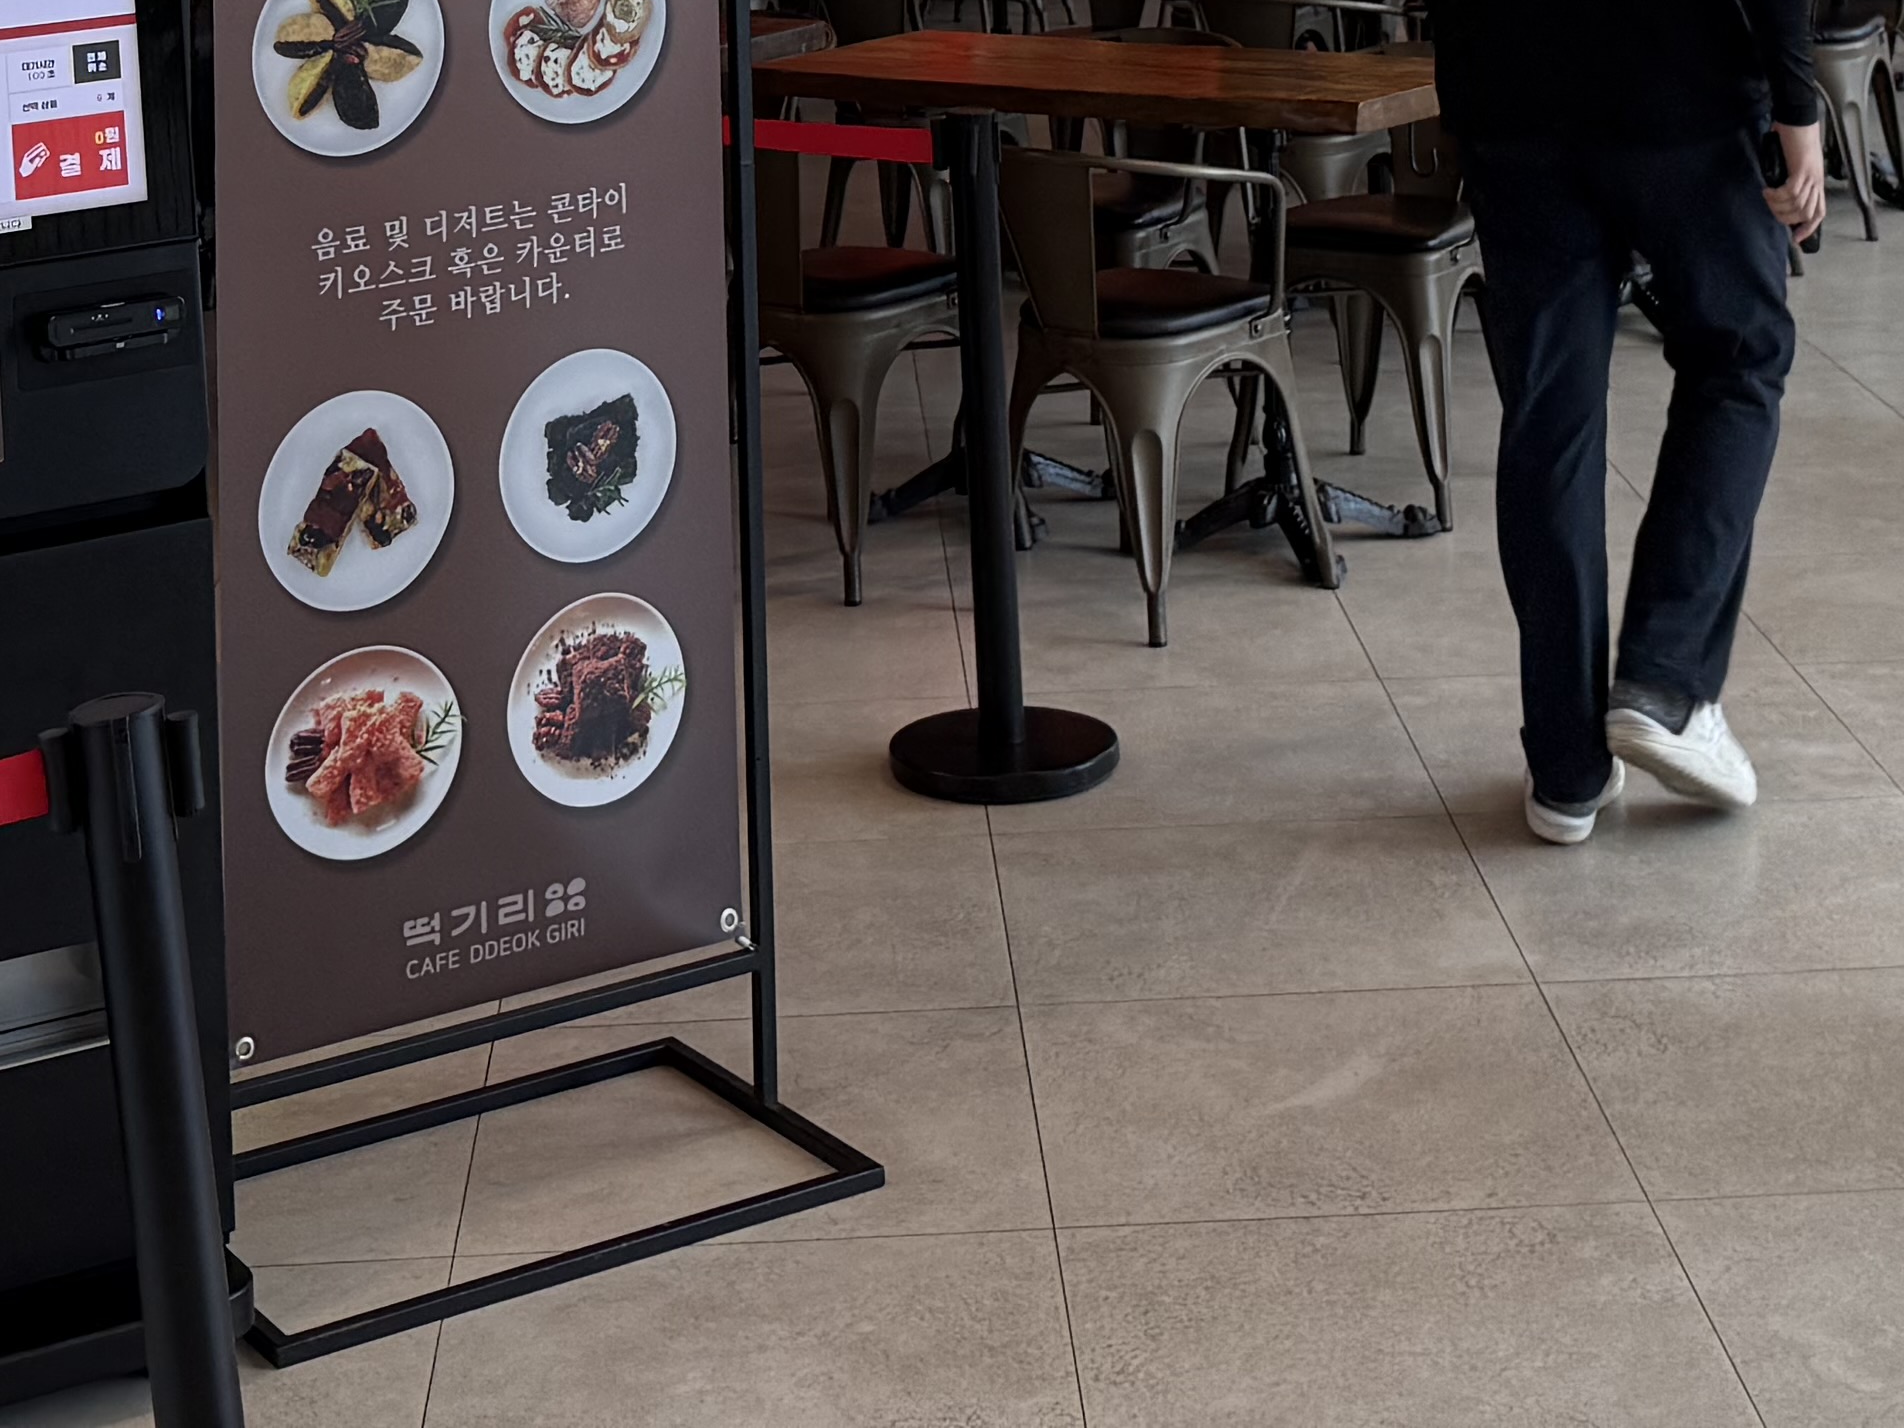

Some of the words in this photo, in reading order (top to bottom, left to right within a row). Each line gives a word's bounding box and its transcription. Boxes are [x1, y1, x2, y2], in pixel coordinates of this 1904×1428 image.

[98, 147, 122, 172] 제
[311, 225, 370, 261] 음료
[384, 216, 409, 252] 및
[424, 200, 537, 242] 디저트는
[547, 181, 628, 224] 콘타이
[318, 255, 436, 300] 키오스크
[447, 243, 505, 278] 혹은
[516, 224, 626, 267] 카운터로
[379, 295, 437, 331] 주문
[449, 272, 571, 319] 바랍니다.
[403, 889, 536, 947] 떡기리
[405, 952, 461, 980] CAFE
[469, 928, 542, 964] DDEOK
[546, 917, 587, 944] GIRI
